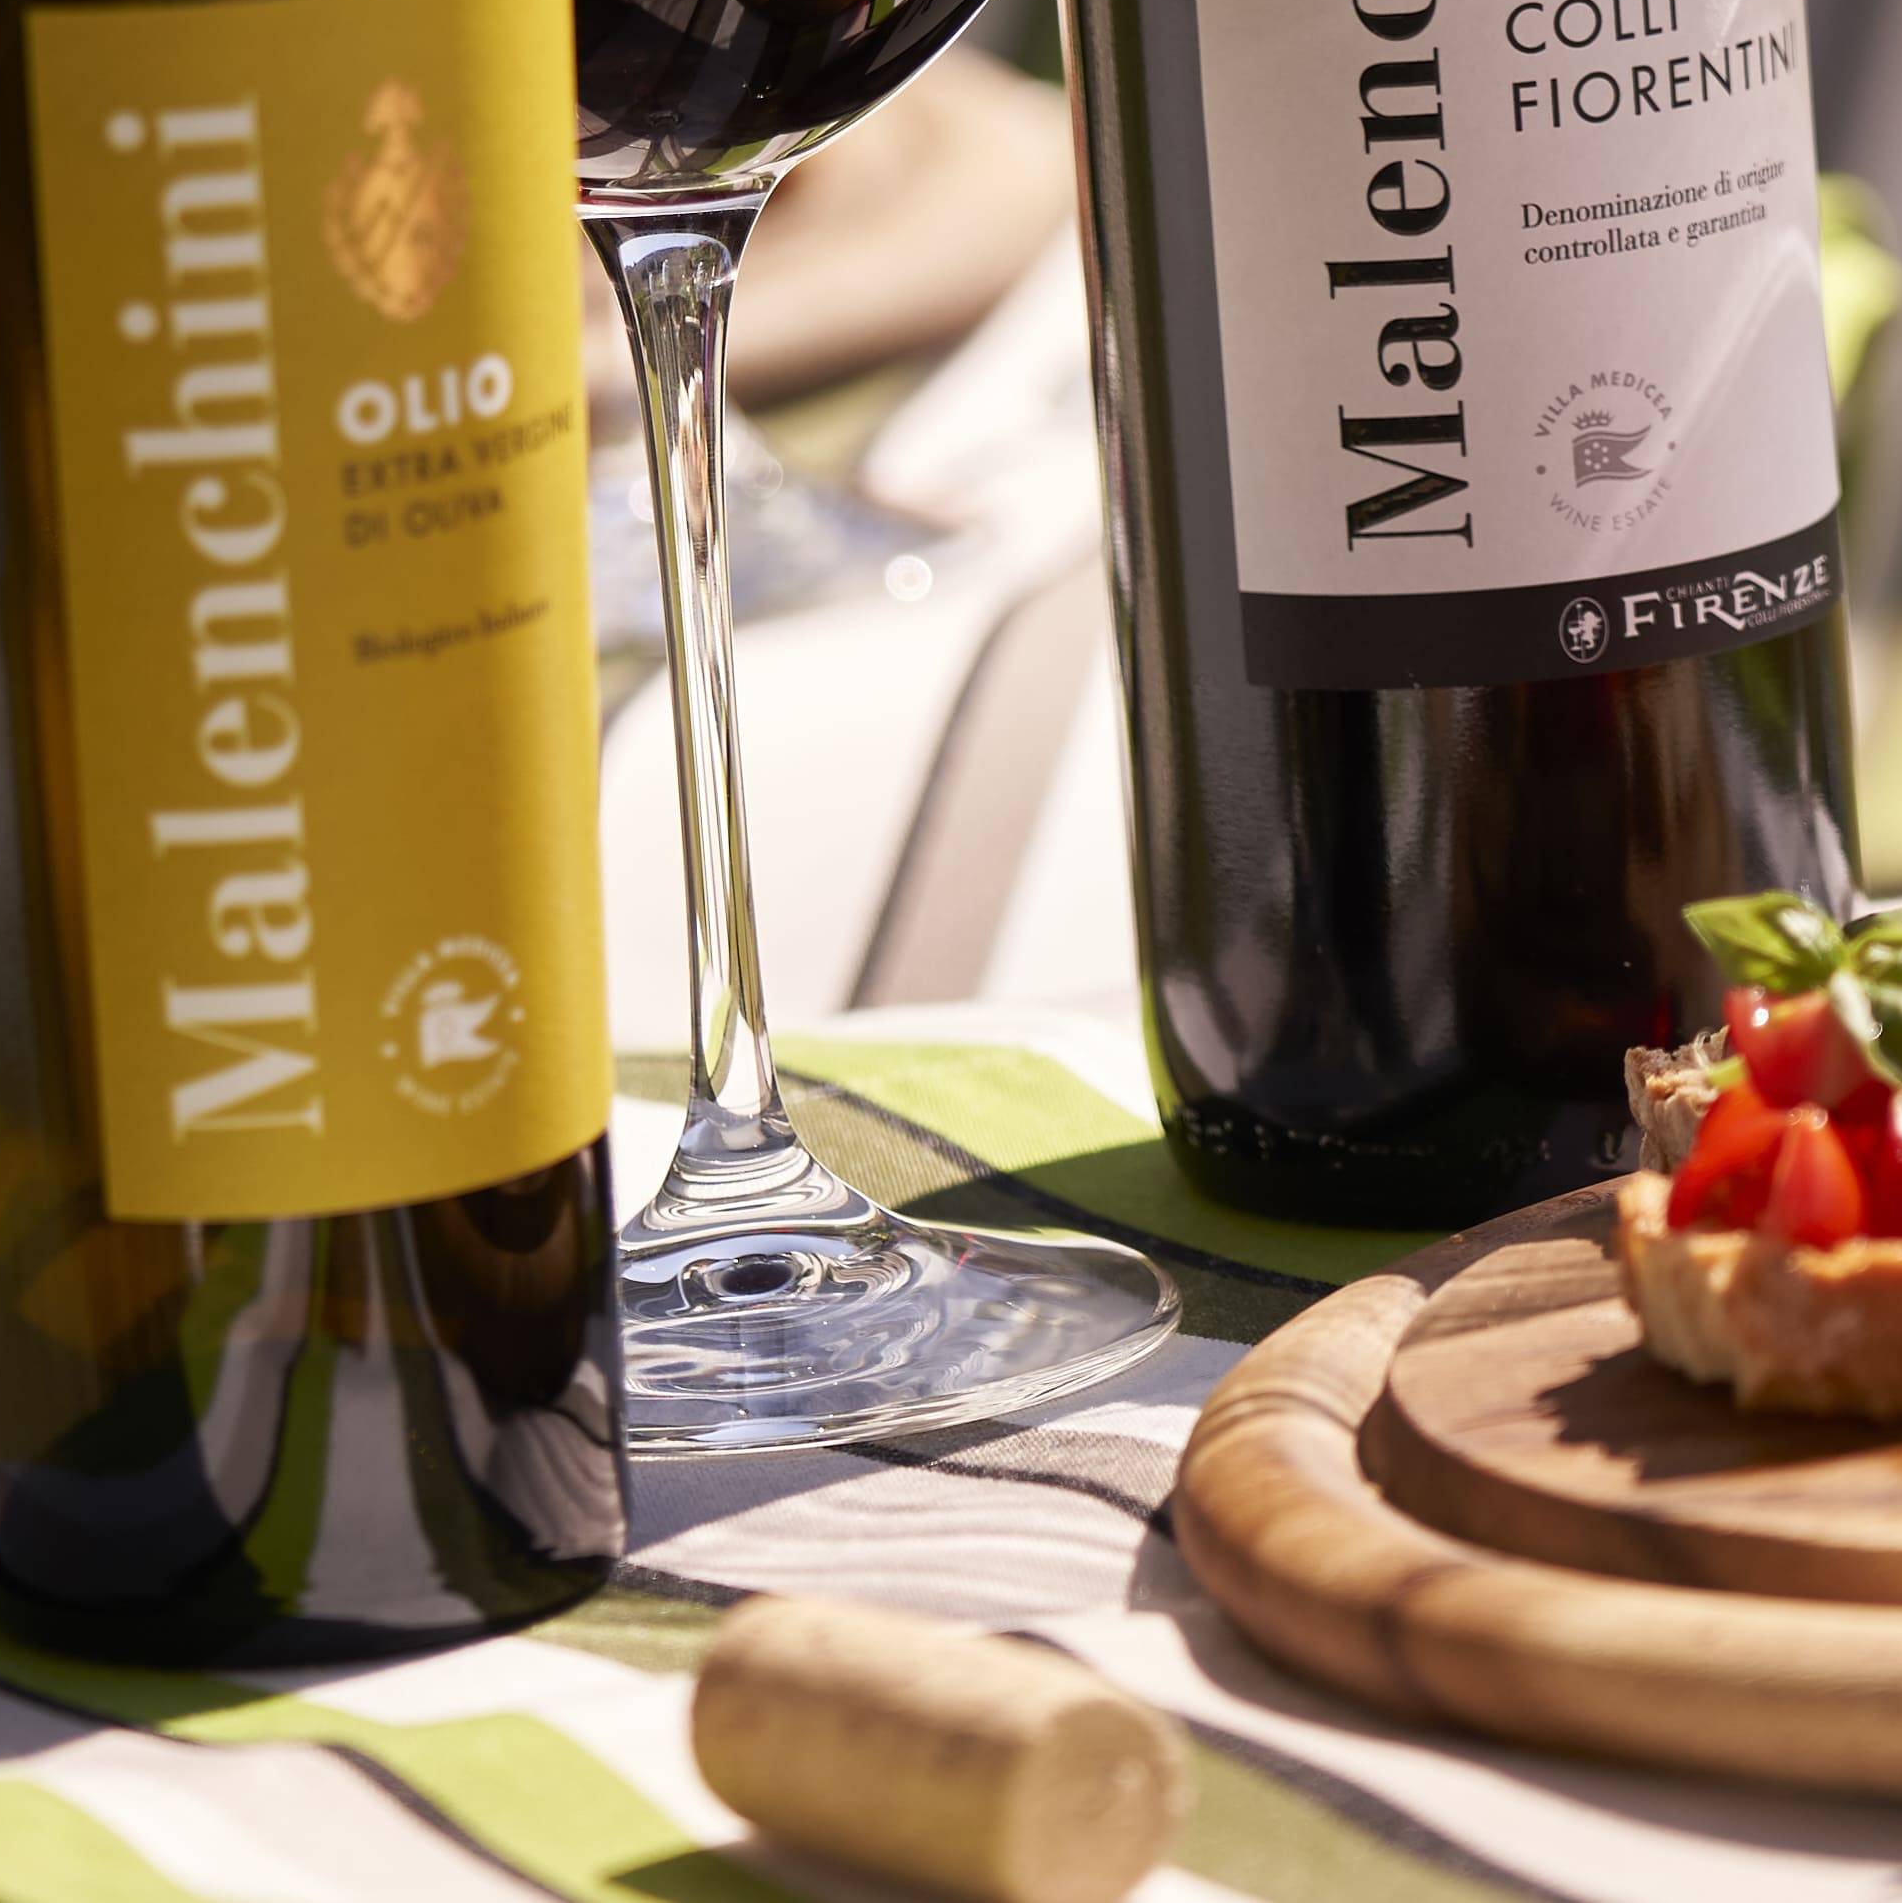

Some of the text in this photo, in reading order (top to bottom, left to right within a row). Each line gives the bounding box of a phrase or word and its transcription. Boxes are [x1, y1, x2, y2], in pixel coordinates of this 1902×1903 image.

[1512, 20, 1796, 132] FIORENTINI
[1521, 158, 1785, 229] Denominazione di origine
[1524, 201, 1767, 265] controllata e garantita
[339, 354, 514, 445] OLIO
[1534, 371, 1673, 438] VILLA MEDICEA
[341, 446, 461, 499] EXTRA
[1550, 477, 1673, 533] WINE ESTATE
[343, 509, 388, 549] DI
[106, 94, 326, 1143] Malenchini
